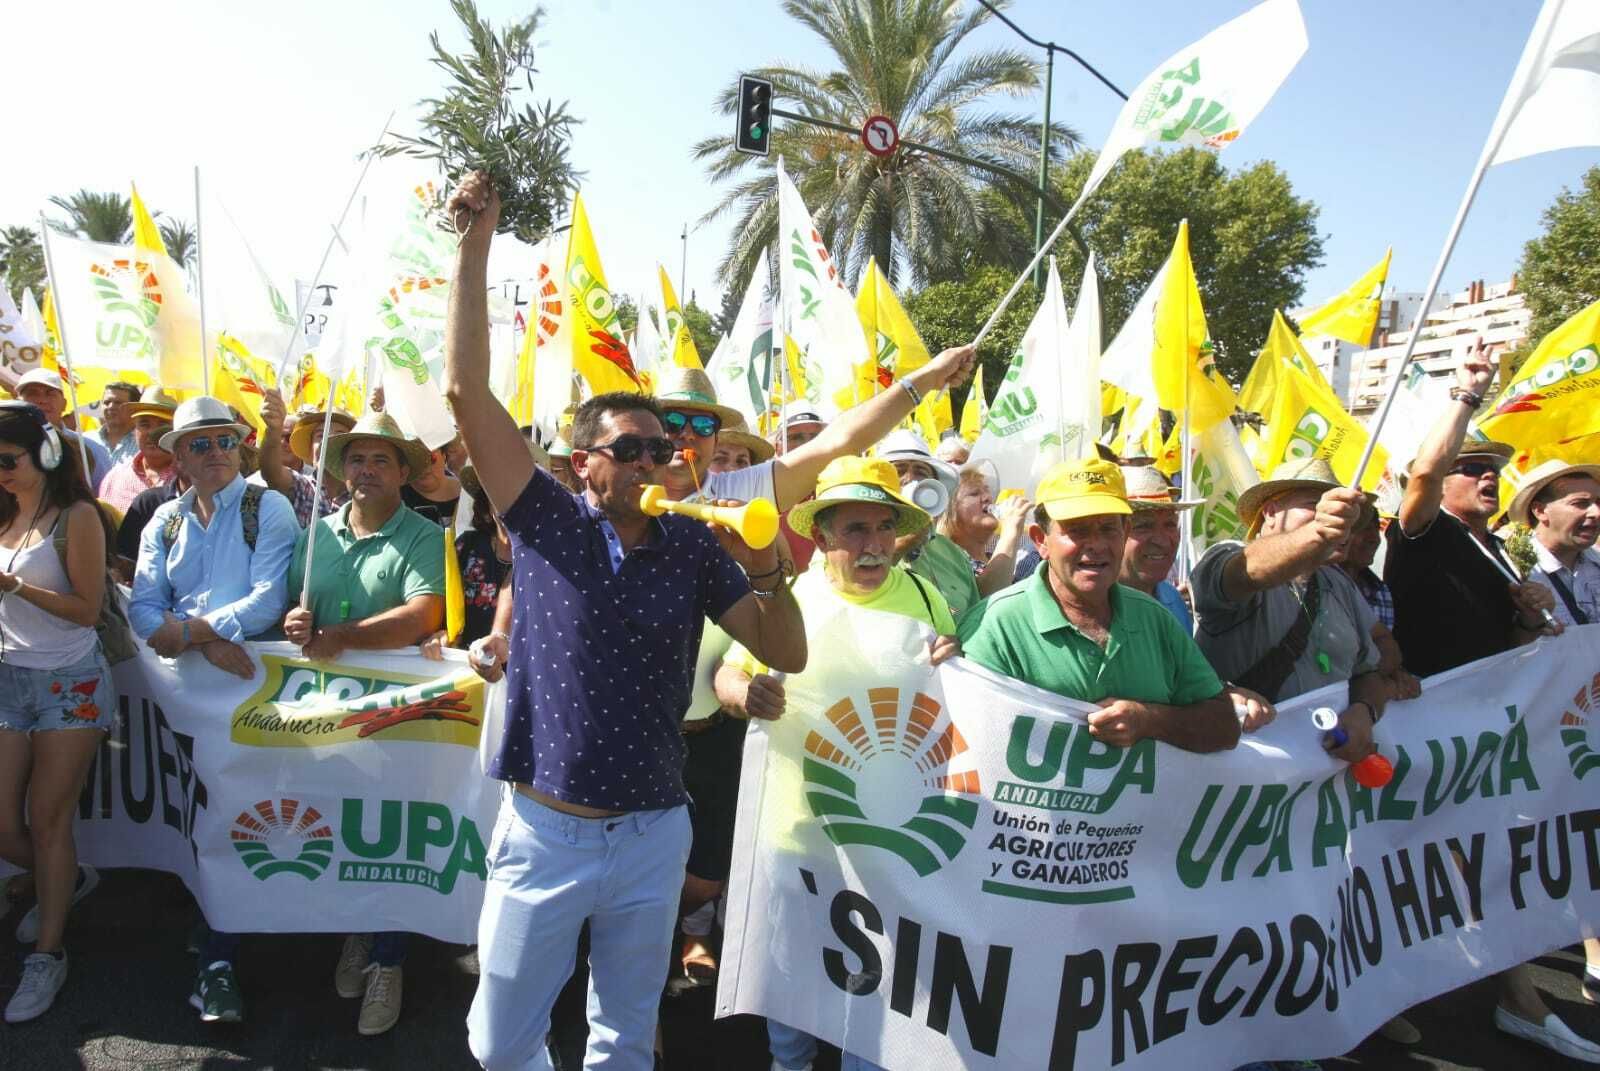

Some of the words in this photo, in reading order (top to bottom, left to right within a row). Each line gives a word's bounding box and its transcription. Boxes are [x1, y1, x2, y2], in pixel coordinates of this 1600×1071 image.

[1006, 714, 1156, 812] UPA
[340, 798, 488, 894] UPA
[987, 832, 1137, 862] AGRICULTORES
[991, 809, 1050, 834] Unión
[1056, 818, 1072, 836] de
[1176, 780, 1313, 889] UPA
[991, 861, 1003, 878] y
[1011, 858, 1129, 886] GANADEROS
[1337, 866, 1382, 988] NO
[1381, 832, 1486, 948] HAY
